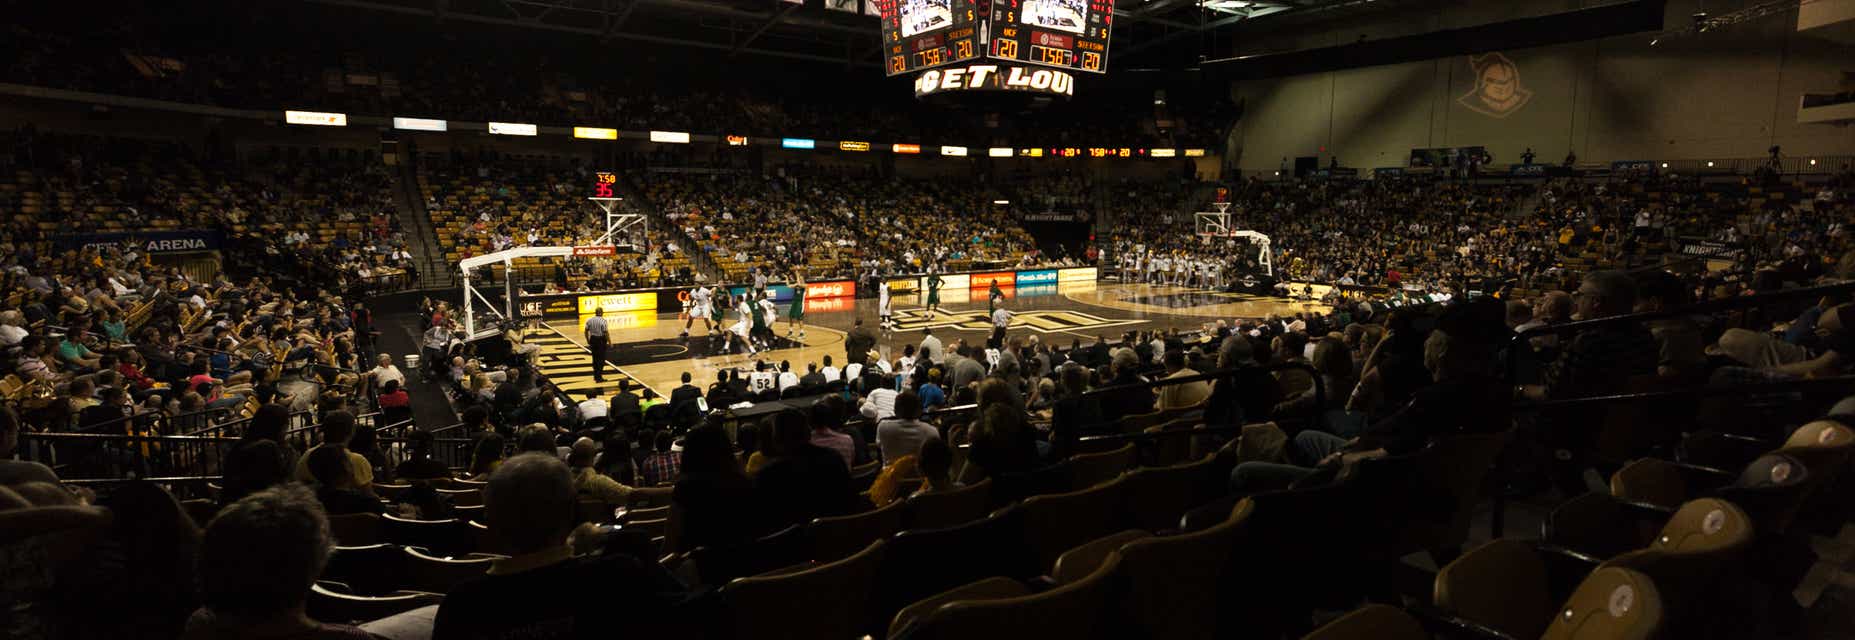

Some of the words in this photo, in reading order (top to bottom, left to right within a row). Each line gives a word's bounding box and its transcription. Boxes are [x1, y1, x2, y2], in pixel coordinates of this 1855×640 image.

[1007, 11, 1014, 23] 5
[1003, 28, 1017, 37] UCF
[1100, 28, 1108, 39] 5
[957, 40, 973, 59] 20
[1000, 39, 1018, 59] 20
[893, 55, 906, 72] 20
[1084, 53, 1100, 70] 20
[921, 65, 998, 93] GET
[595, 183, 614, 198] 35
[146, 239, 208, 252] ARENA
[756, 378, 771, 390] 52
